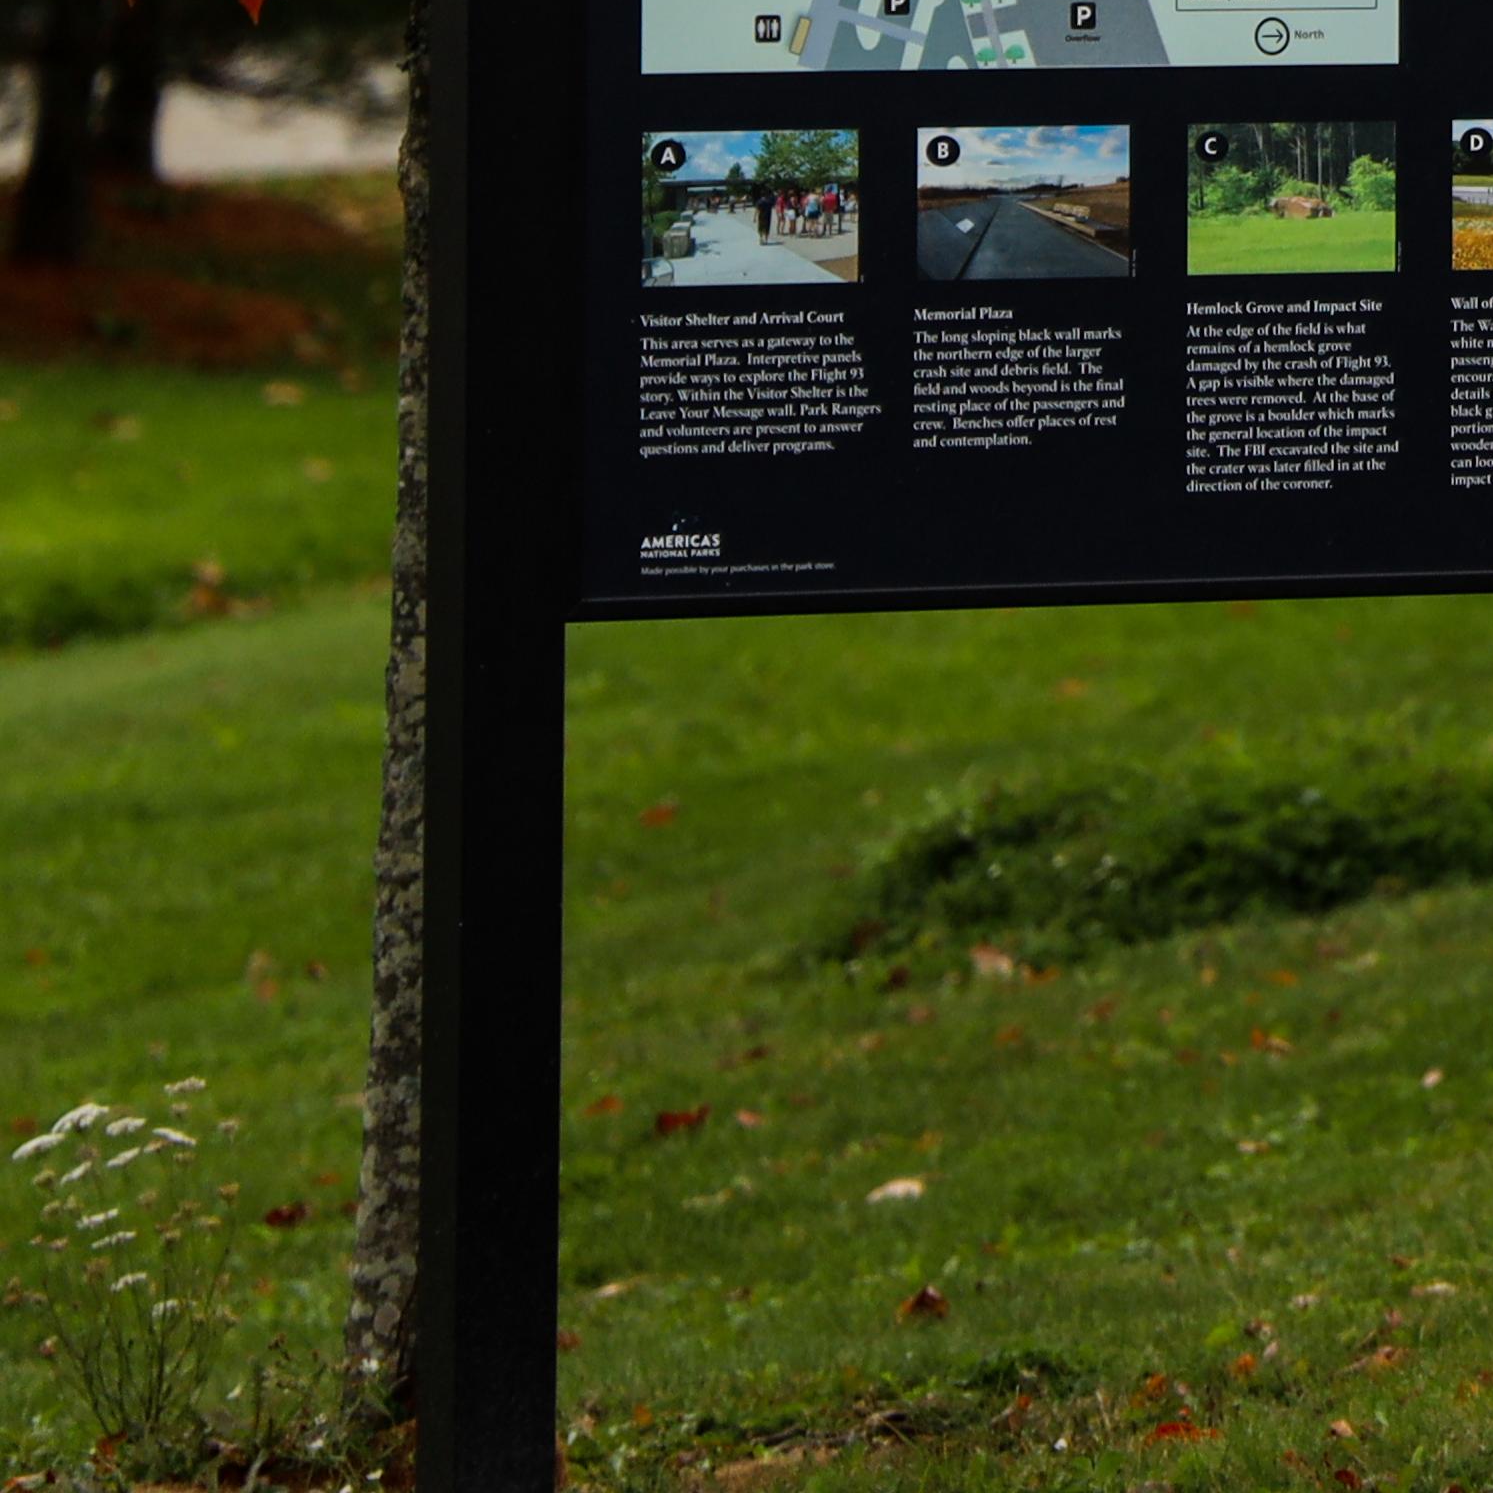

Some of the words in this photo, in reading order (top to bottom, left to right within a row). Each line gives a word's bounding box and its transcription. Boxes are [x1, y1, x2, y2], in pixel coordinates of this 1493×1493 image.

[1294, 29, 1325, 40] North
[937, 143, 948, 159] B
[1204, 137, 1217, 155] C
[1470, 134, 1484, 152] D
[660, 147, 676, 164] A
[1186, 301, 1243, 315] Hemlock
[1246, 300, 1284, 314] Grove
[1286, 300, 1310, 313] and
[1313, 299, 1357, 315] Impact
[1359, 298, 1382, 312] Site
[1450, 296, 1478, 310] Wall
[640, 313, 683, 328] Visitor
[685, 312, 731, 326] Shelter
[732, 312, 757, 326] and
[759, 311, 804, 325] Arrival
[806, 310, 844, 324] Court
[914, 307, 976, 321] Memorial
[979, 307, 1013, 319] Plaza
[1450, 319, 1475, 332] The
[913, 330, 938, 344] The
[941, 330, 969, 347] long
[971, 329, 1016, 346] sloping
[1018, 328, 1052, 342] black
[1054, 327, 1080, 341] wall
[1083, 326, 1122, 340] marks
[640, 549, 688, 559] NATIONAL
[690, 549, 720, 557] PARKS
